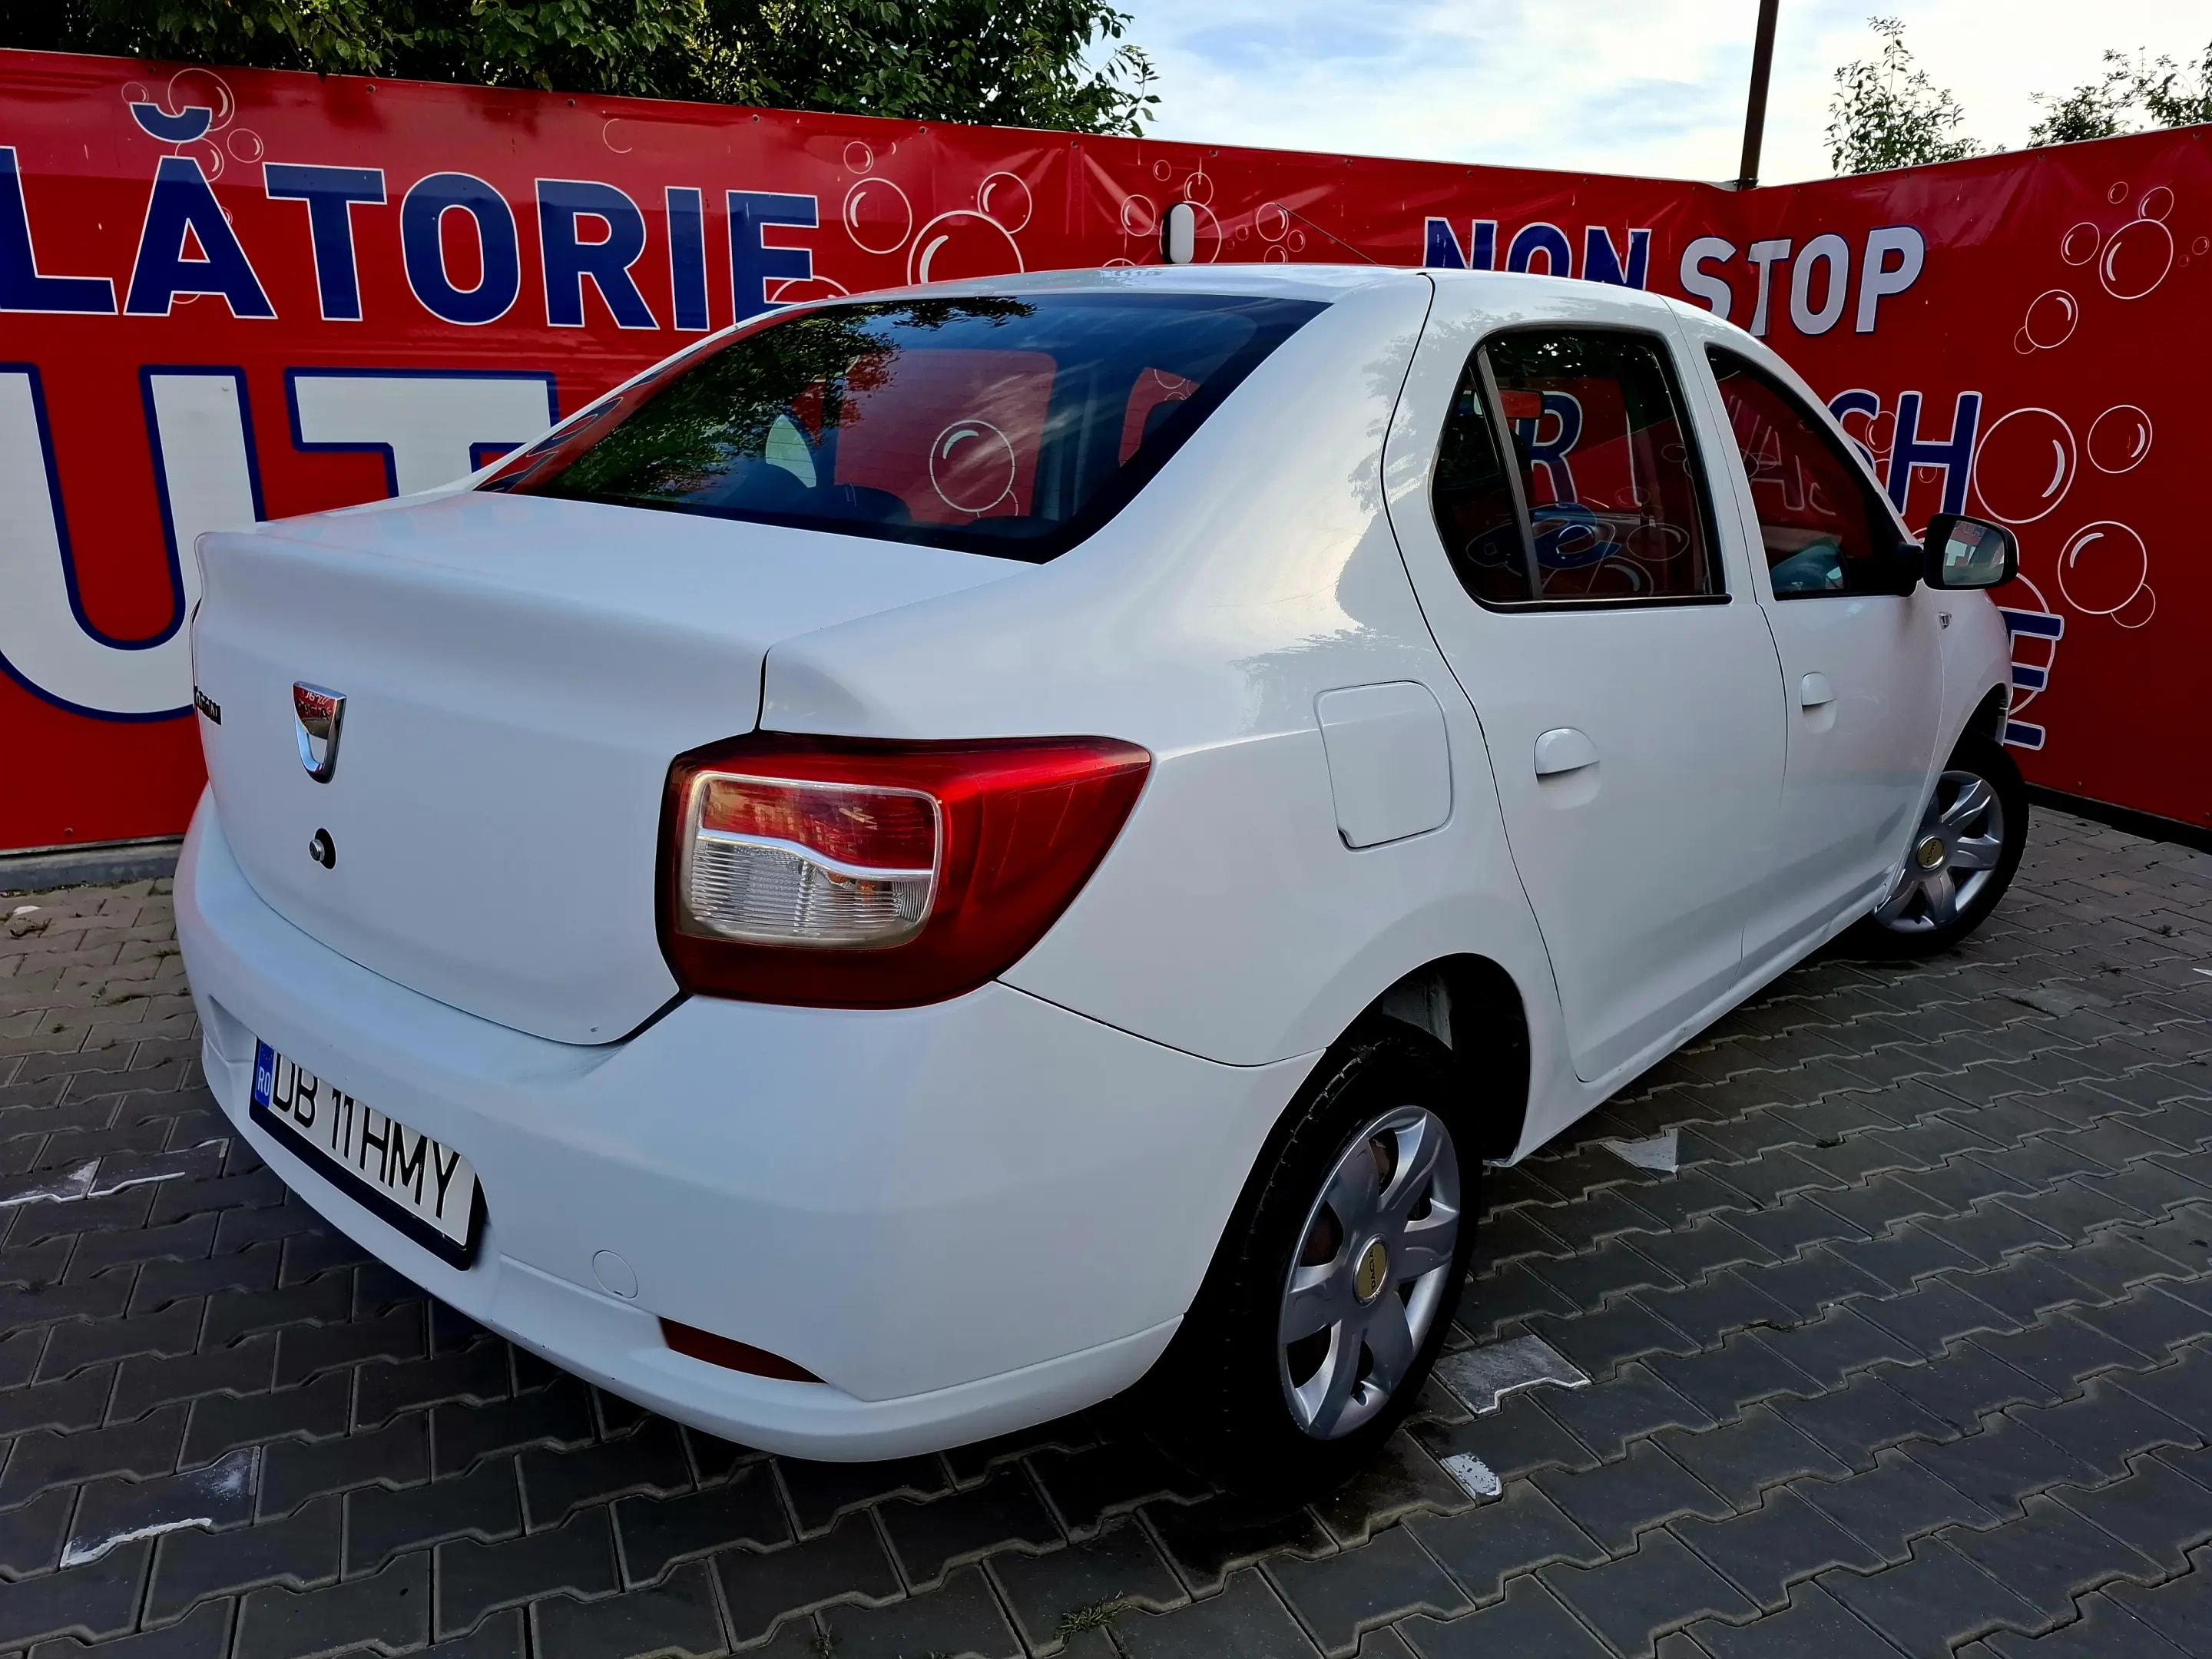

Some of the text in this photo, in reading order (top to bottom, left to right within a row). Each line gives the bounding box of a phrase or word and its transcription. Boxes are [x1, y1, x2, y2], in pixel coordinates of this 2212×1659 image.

[1424, 217, 1926, 336] NON STOP
[257, 1066, 271, 1097] RO
[272, 1052, 461, 1220] DB 11 HMY
